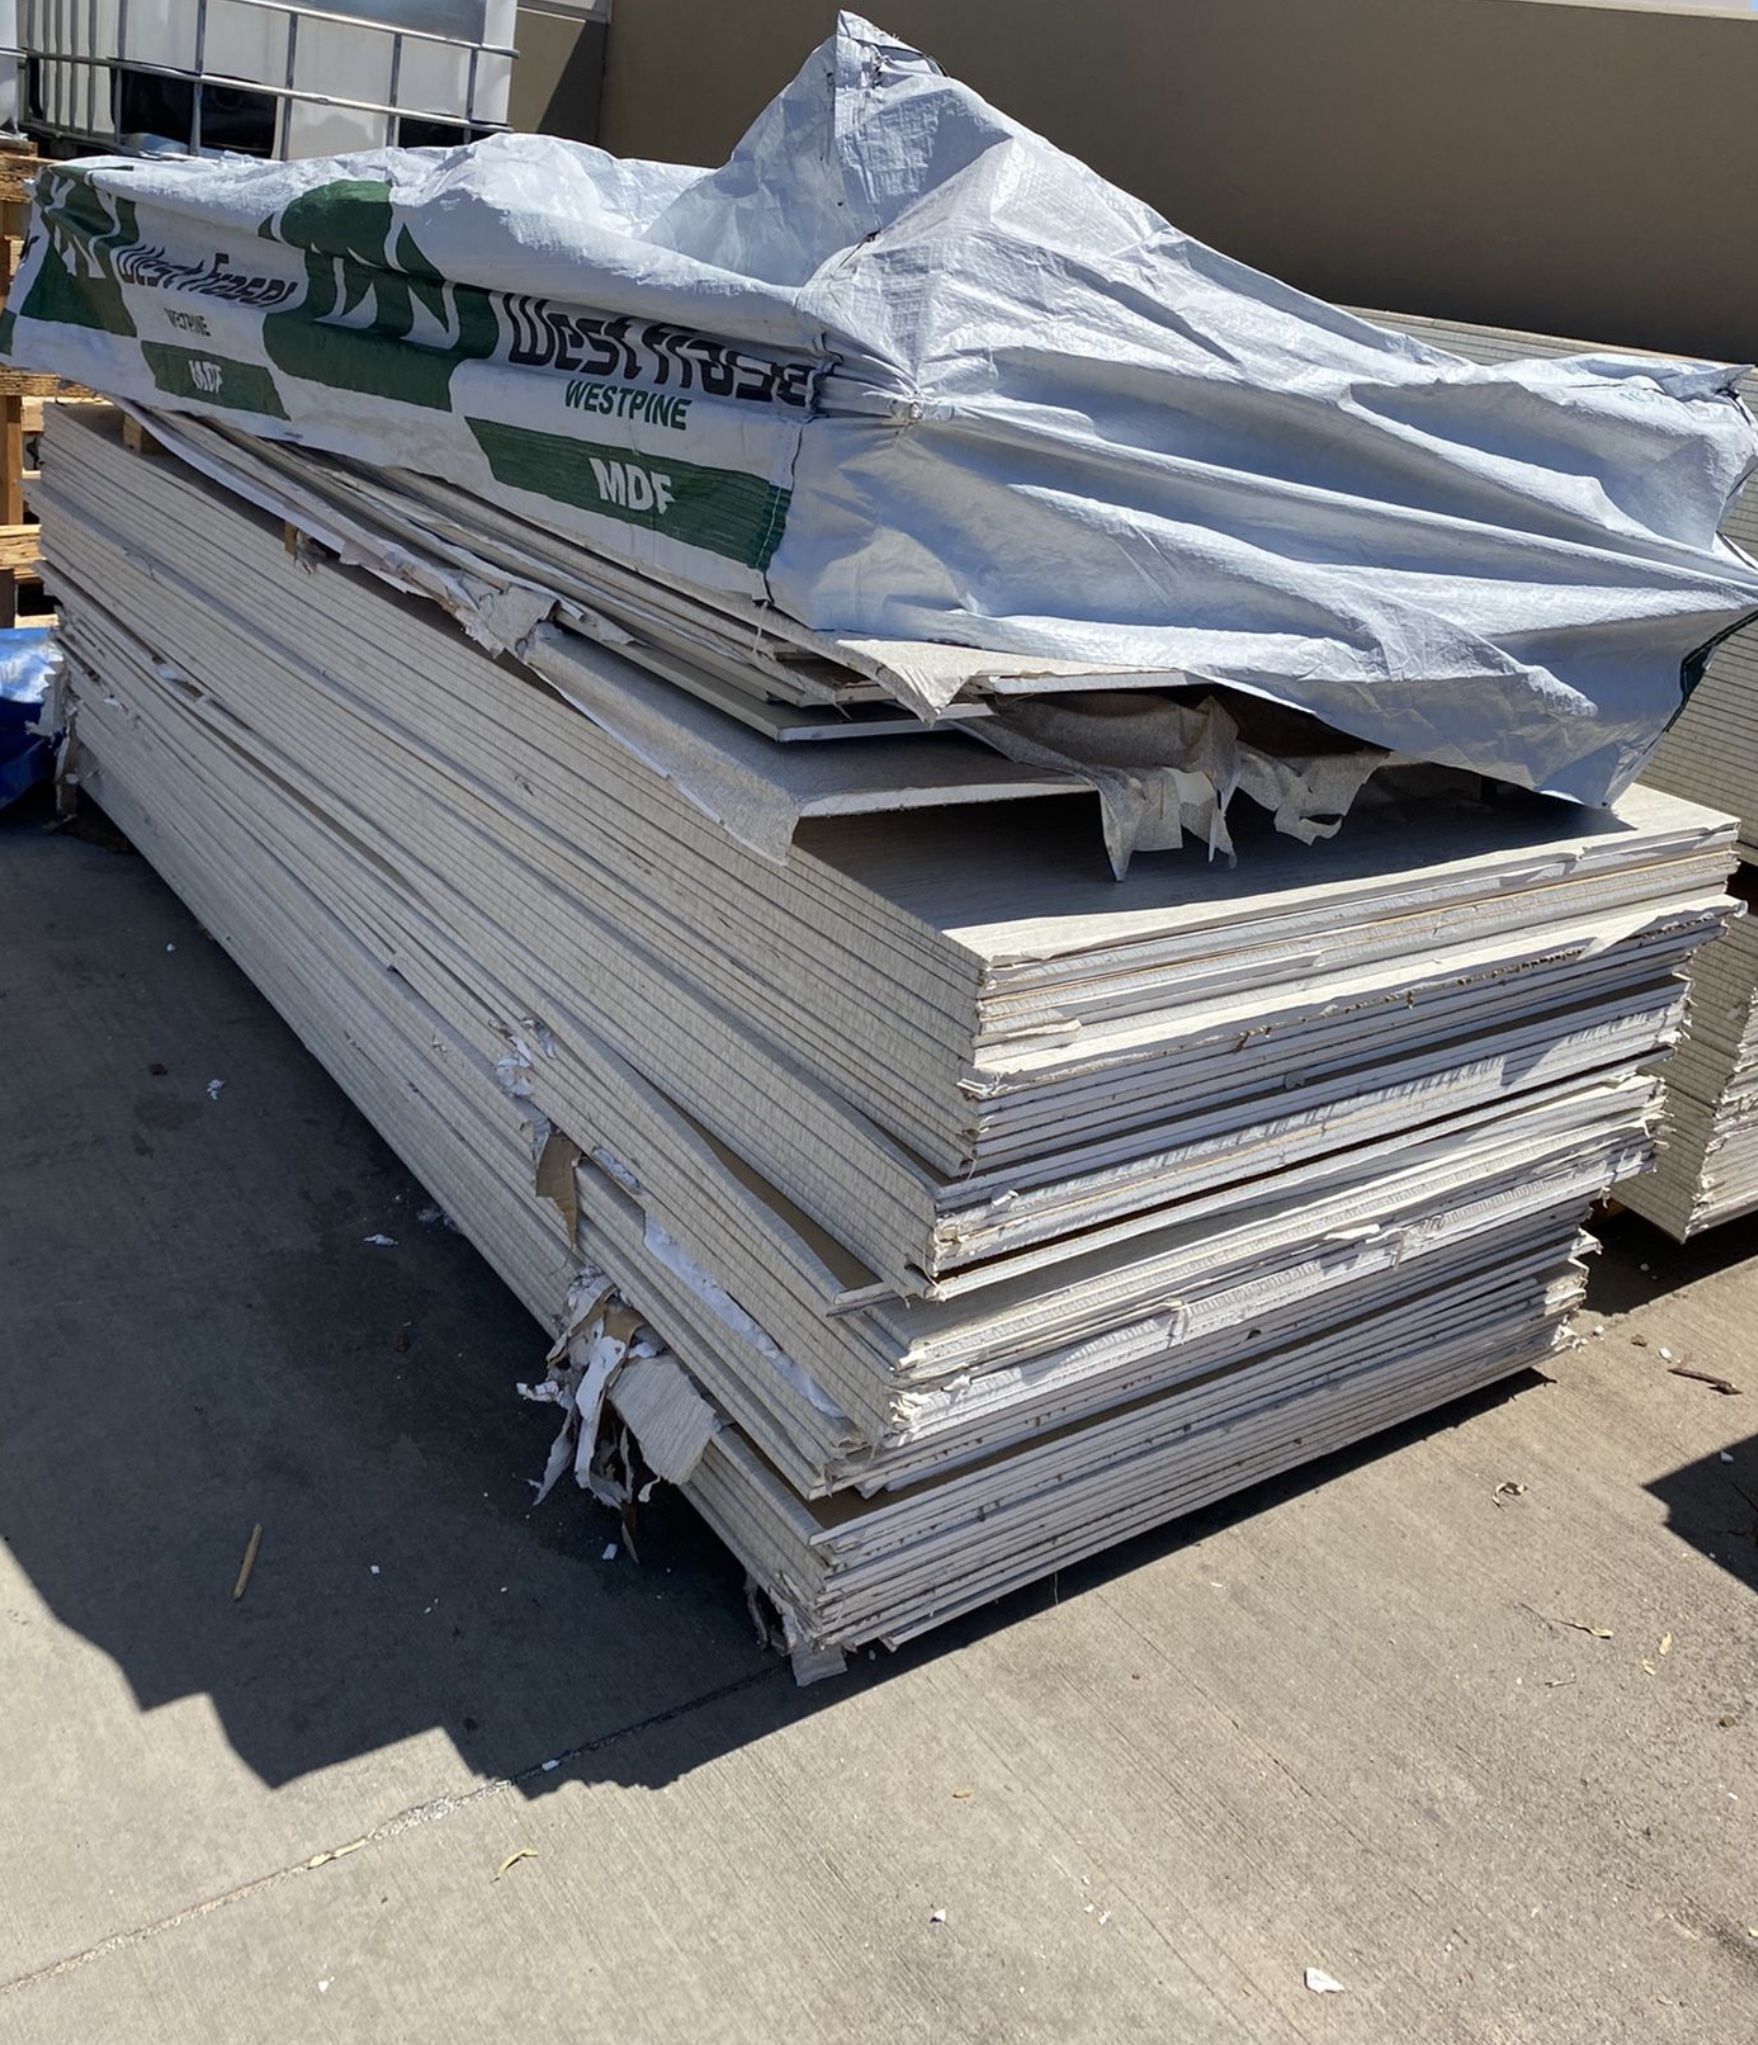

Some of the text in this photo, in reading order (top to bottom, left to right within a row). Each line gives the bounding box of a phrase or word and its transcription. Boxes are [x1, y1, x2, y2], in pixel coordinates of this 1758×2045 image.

[502, 292, 813, 408] West Frase
[564, 379, 693, 431] WESTPINE
[589, 457, 676, 515] MDF
